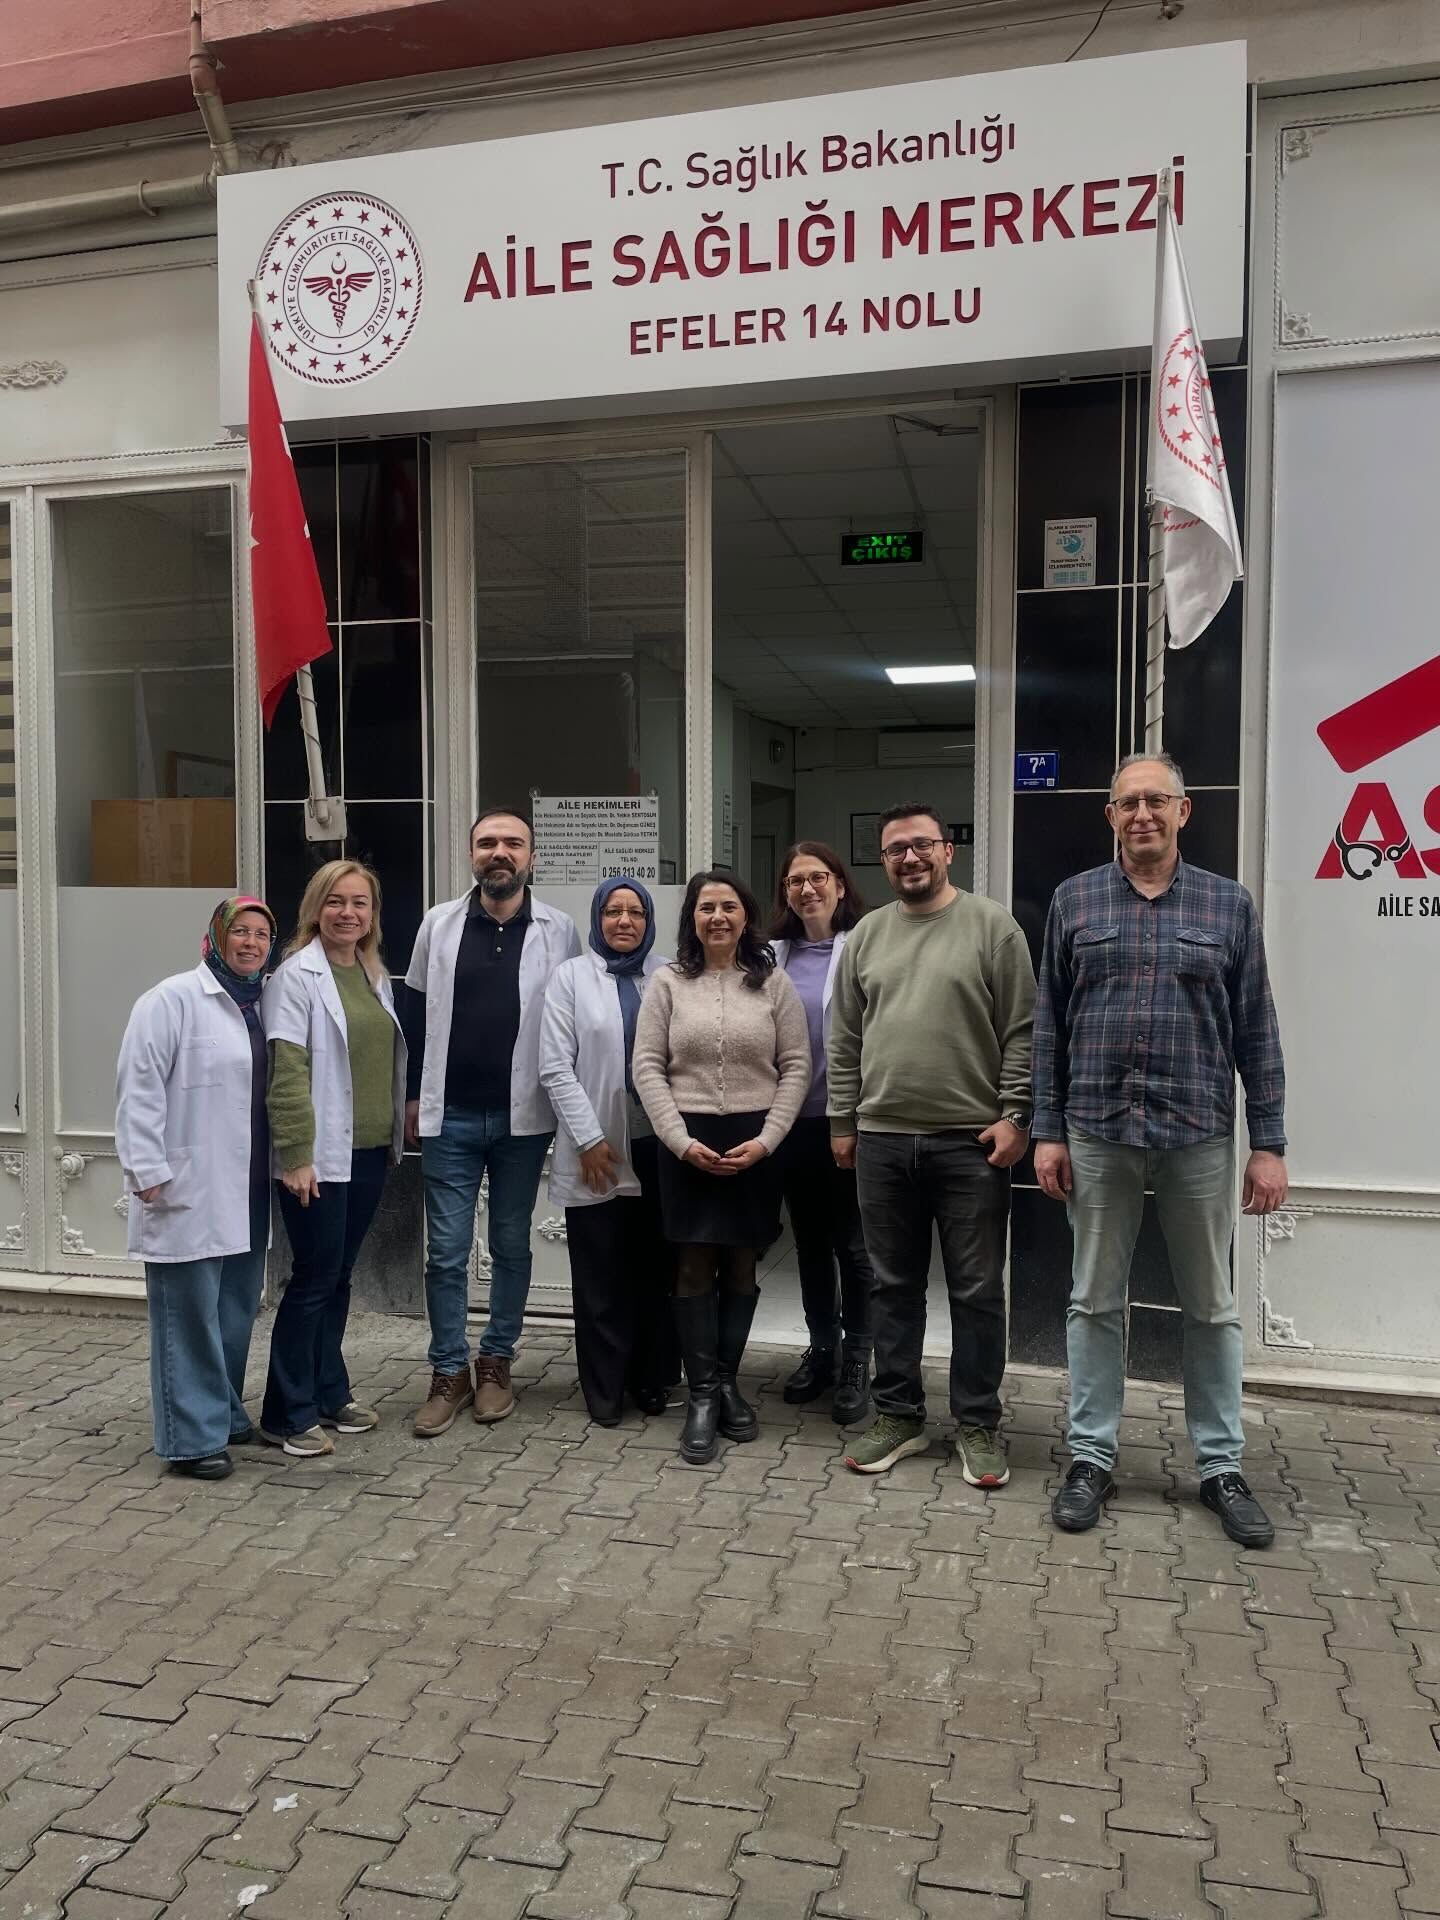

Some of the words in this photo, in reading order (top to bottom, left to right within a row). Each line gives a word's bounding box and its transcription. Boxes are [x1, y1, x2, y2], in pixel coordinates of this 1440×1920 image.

[601, 159, 673, 199] T.C.
[687, 140, 807, 193] Sağlık
[823, 113, 1016, 173] Bakanlığı
[463, 235, 593, 304] AİLE
[612, 199, 855, 287] SAĞLIĞI
[882, 155, 1185, 260] MERKEZİ
[287, 230, 348, 292] CUMHURİYETİ
[351, 233, 387, 266] SAĞLIK
[363, 268, 392, 338] BAKANLIĞI
[630, 307, 786, 356] EFELER
[803, 302, 848, 340] 14
[863, 286, 982, 335] NOLU
[851, 546, 912, 561] ÇIKIŞ
[858, 535, 907, 547] EXIT
[557, 800, 581, 809] AİLE
[583, 800, 641, 809] HEKİMLERİ
[602, 866, 607, 878] 0
[608, 866, 621, 878] 256
[622, 866, 635, 878] 213
[636, 866, 646, 878] 40
[646, 866, 656, 878] 20
[1377, 892, 1414, 917] AİLE
